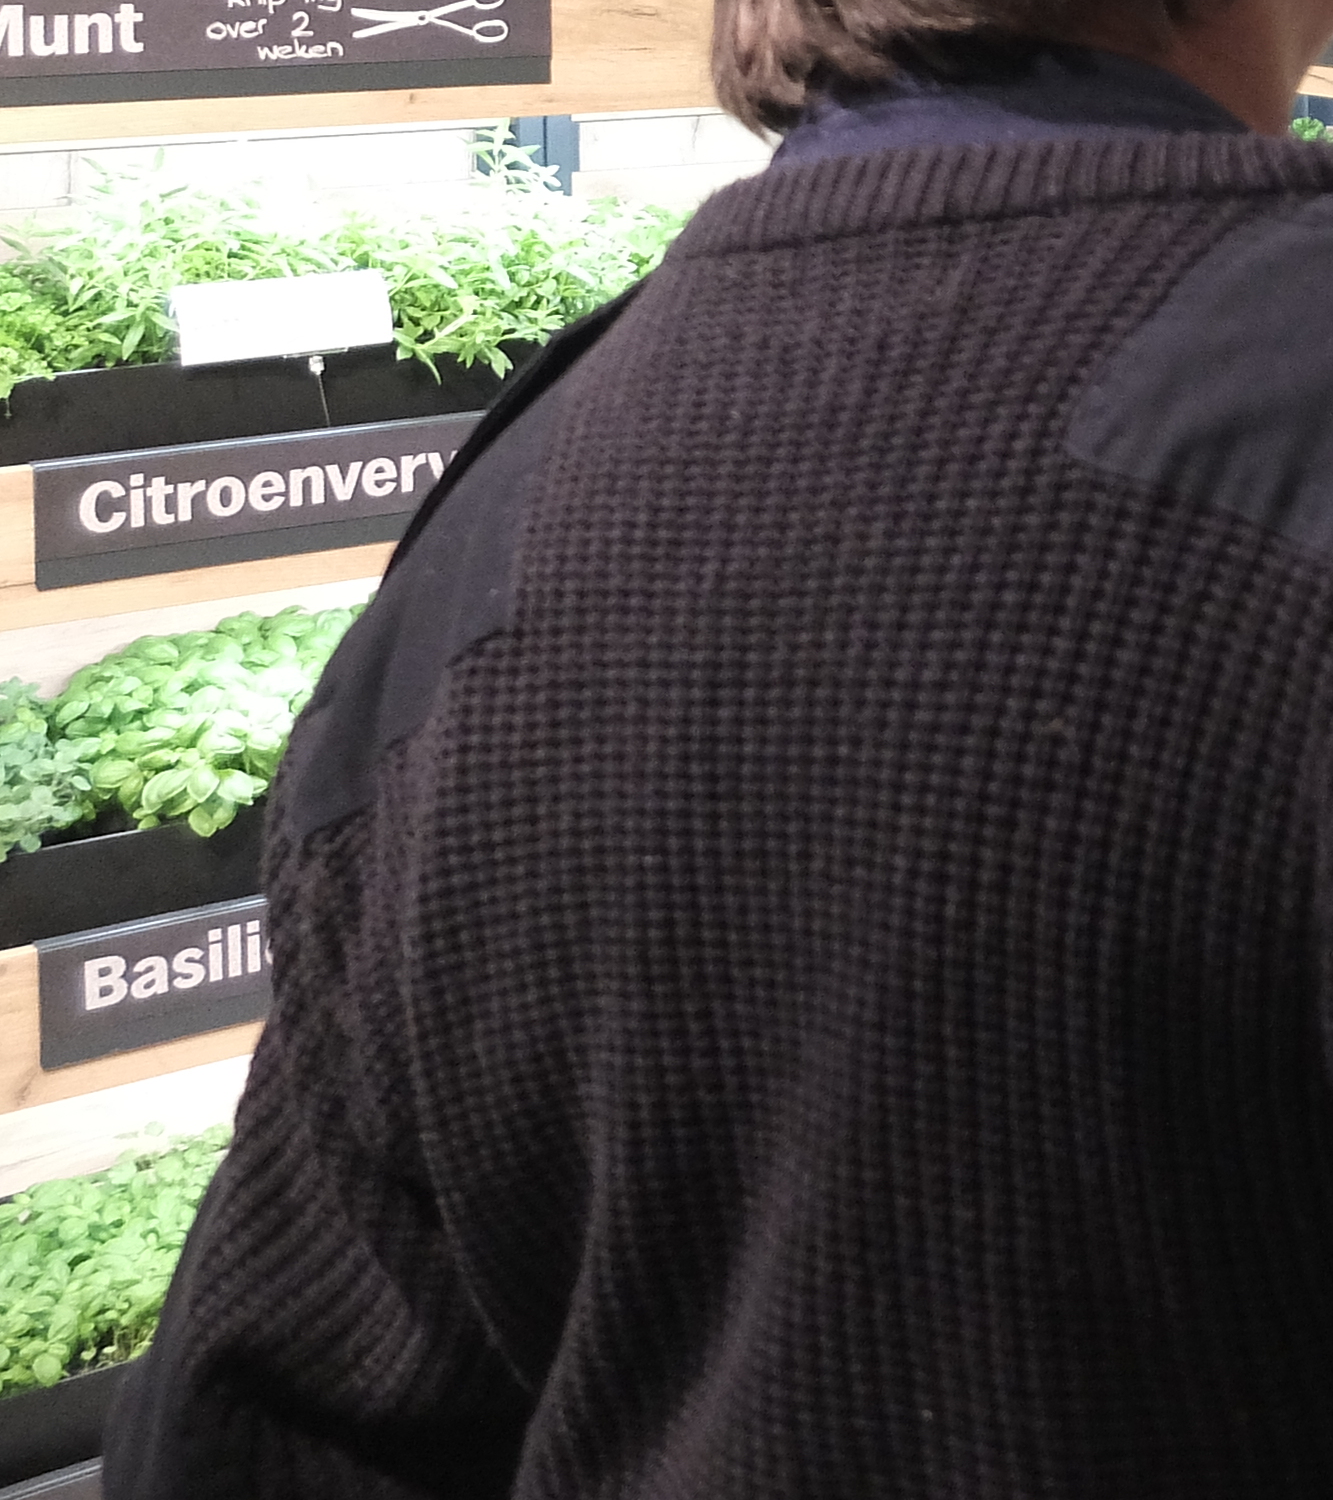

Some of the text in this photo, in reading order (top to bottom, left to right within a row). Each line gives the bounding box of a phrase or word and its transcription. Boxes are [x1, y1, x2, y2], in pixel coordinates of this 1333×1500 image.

[206, 11, 315, 40] over 2
[257, 38, 344, 60] weken
[84, 920, 274, 1010] Basili
